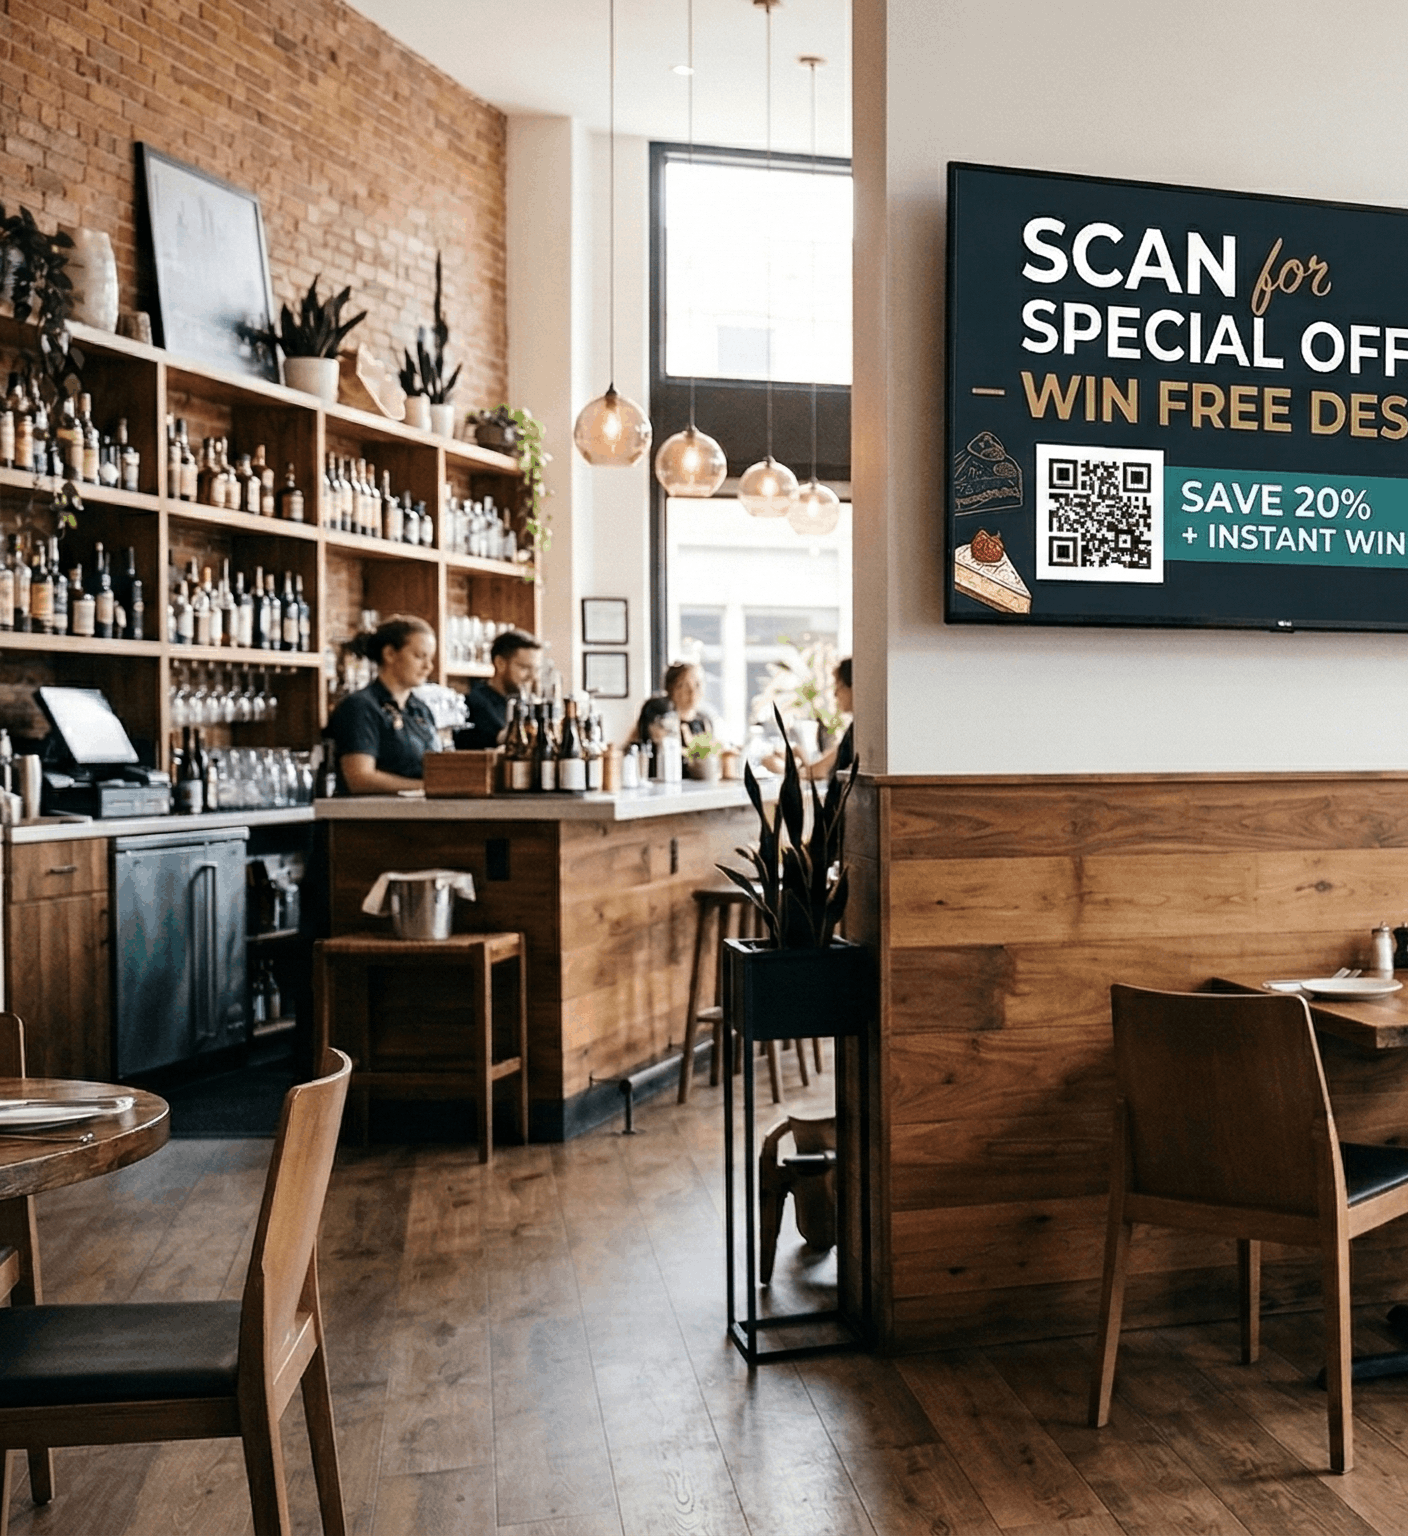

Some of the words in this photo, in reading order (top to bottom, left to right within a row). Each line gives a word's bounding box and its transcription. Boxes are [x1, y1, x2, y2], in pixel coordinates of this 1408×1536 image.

[1021, 217, 1236, 298] SCAN
[1251, 237, 1332, 317] for
[1021, 299, 1284, 369] SPECIAL
[1020, 371, 1138, 424] WIN
[1159, 380, 1292, 433] FREE
[1181, 480, 1284, 517] SAVE
[1293, 485, 1371, 520] 20%
[1181, 526, 1198, 544] +
[1209, 523, 1337, 553] INSTANT
[1344, 529, 1406, 556] WIN
